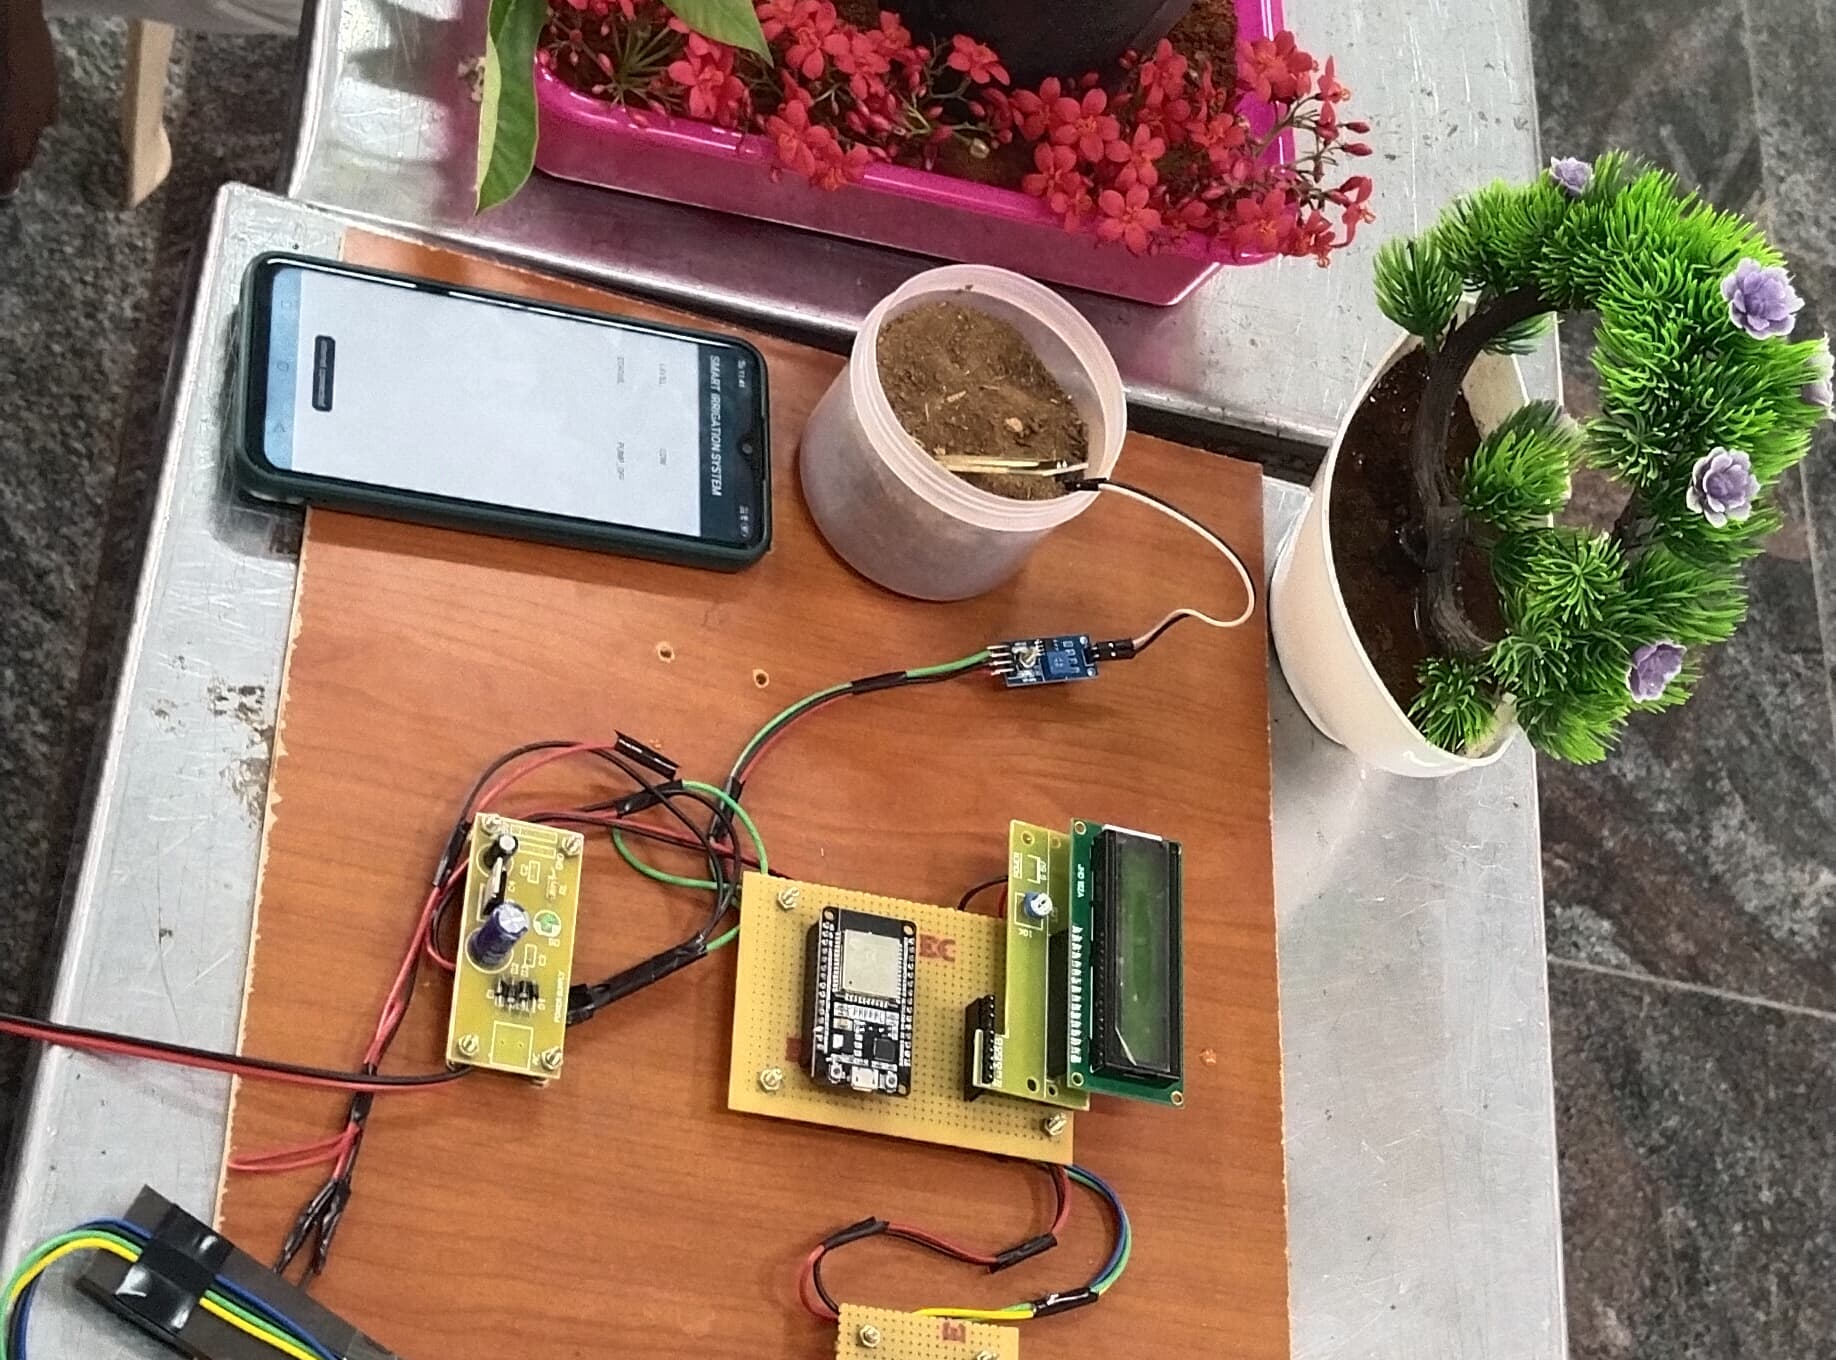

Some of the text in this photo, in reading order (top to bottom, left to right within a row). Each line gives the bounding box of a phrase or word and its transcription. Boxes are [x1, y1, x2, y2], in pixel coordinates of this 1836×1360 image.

[710, 355, 722, 496] SMART IRRIGATION SYSTEM
